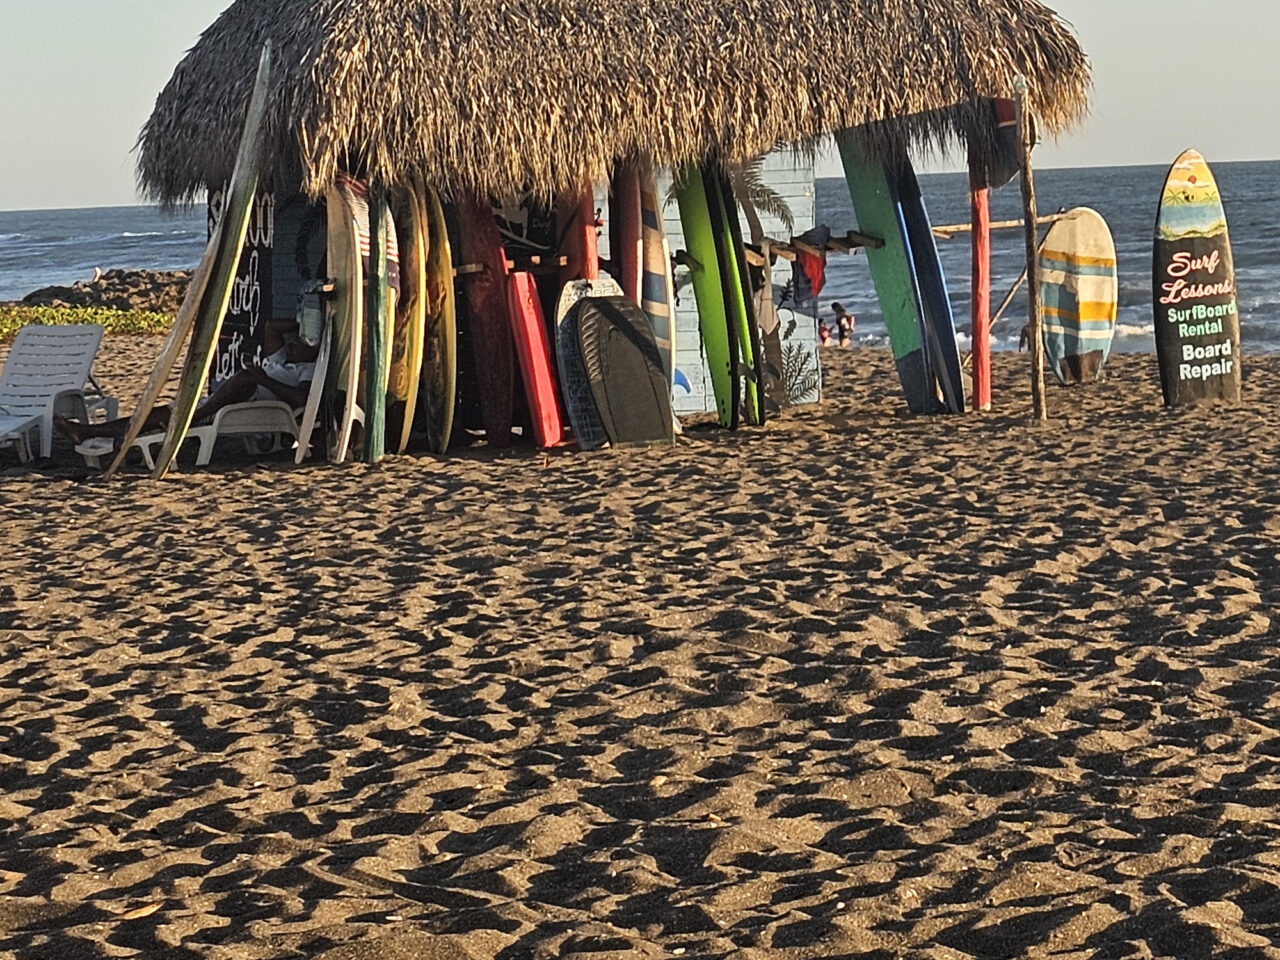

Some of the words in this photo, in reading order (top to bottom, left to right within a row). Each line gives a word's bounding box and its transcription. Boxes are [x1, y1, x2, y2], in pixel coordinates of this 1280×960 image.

[1167, 250, 1220, 277] Surf
[1159, 279, 1233, 304] Lessons
[1168, 300, 1236, 323] SurfBoard
[1179, 319, 1223, 338] Rental
[1182, 339, 1232, 361] Board
[1179, 359, 1233, 381] Repair
